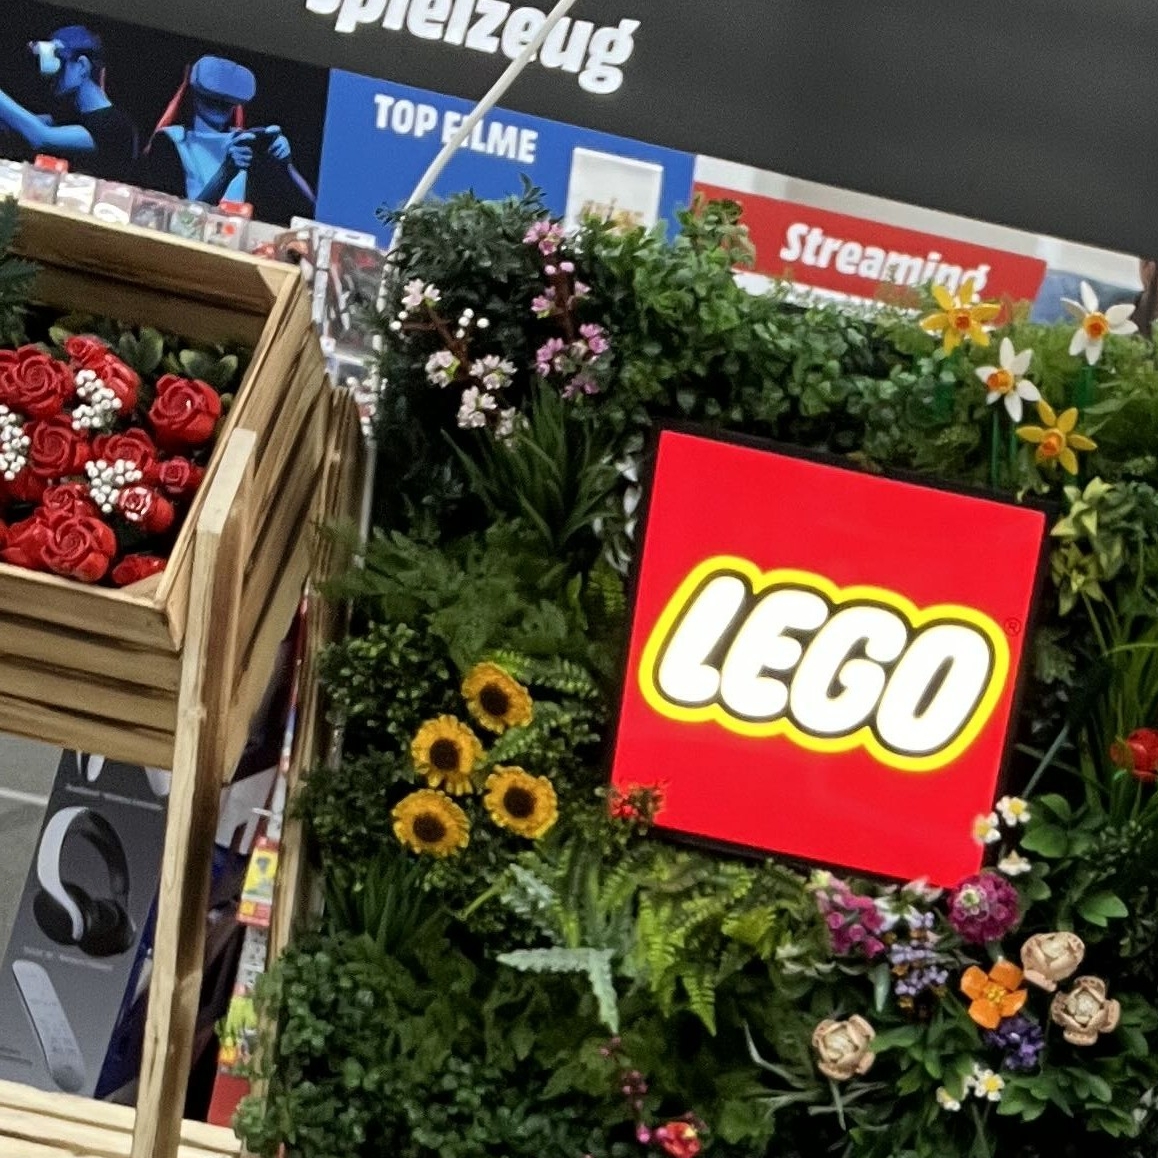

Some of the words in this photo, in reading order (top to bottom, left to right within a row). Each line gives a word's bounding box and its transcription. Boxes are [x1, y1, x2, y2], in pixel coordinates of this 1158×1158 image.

[304, 0, 641, 94] pelzeug
[373, 94, 439, 138] TOP
[779, 222, 991, 304] Streaming
[653, 568, 997, 759] LEGO
